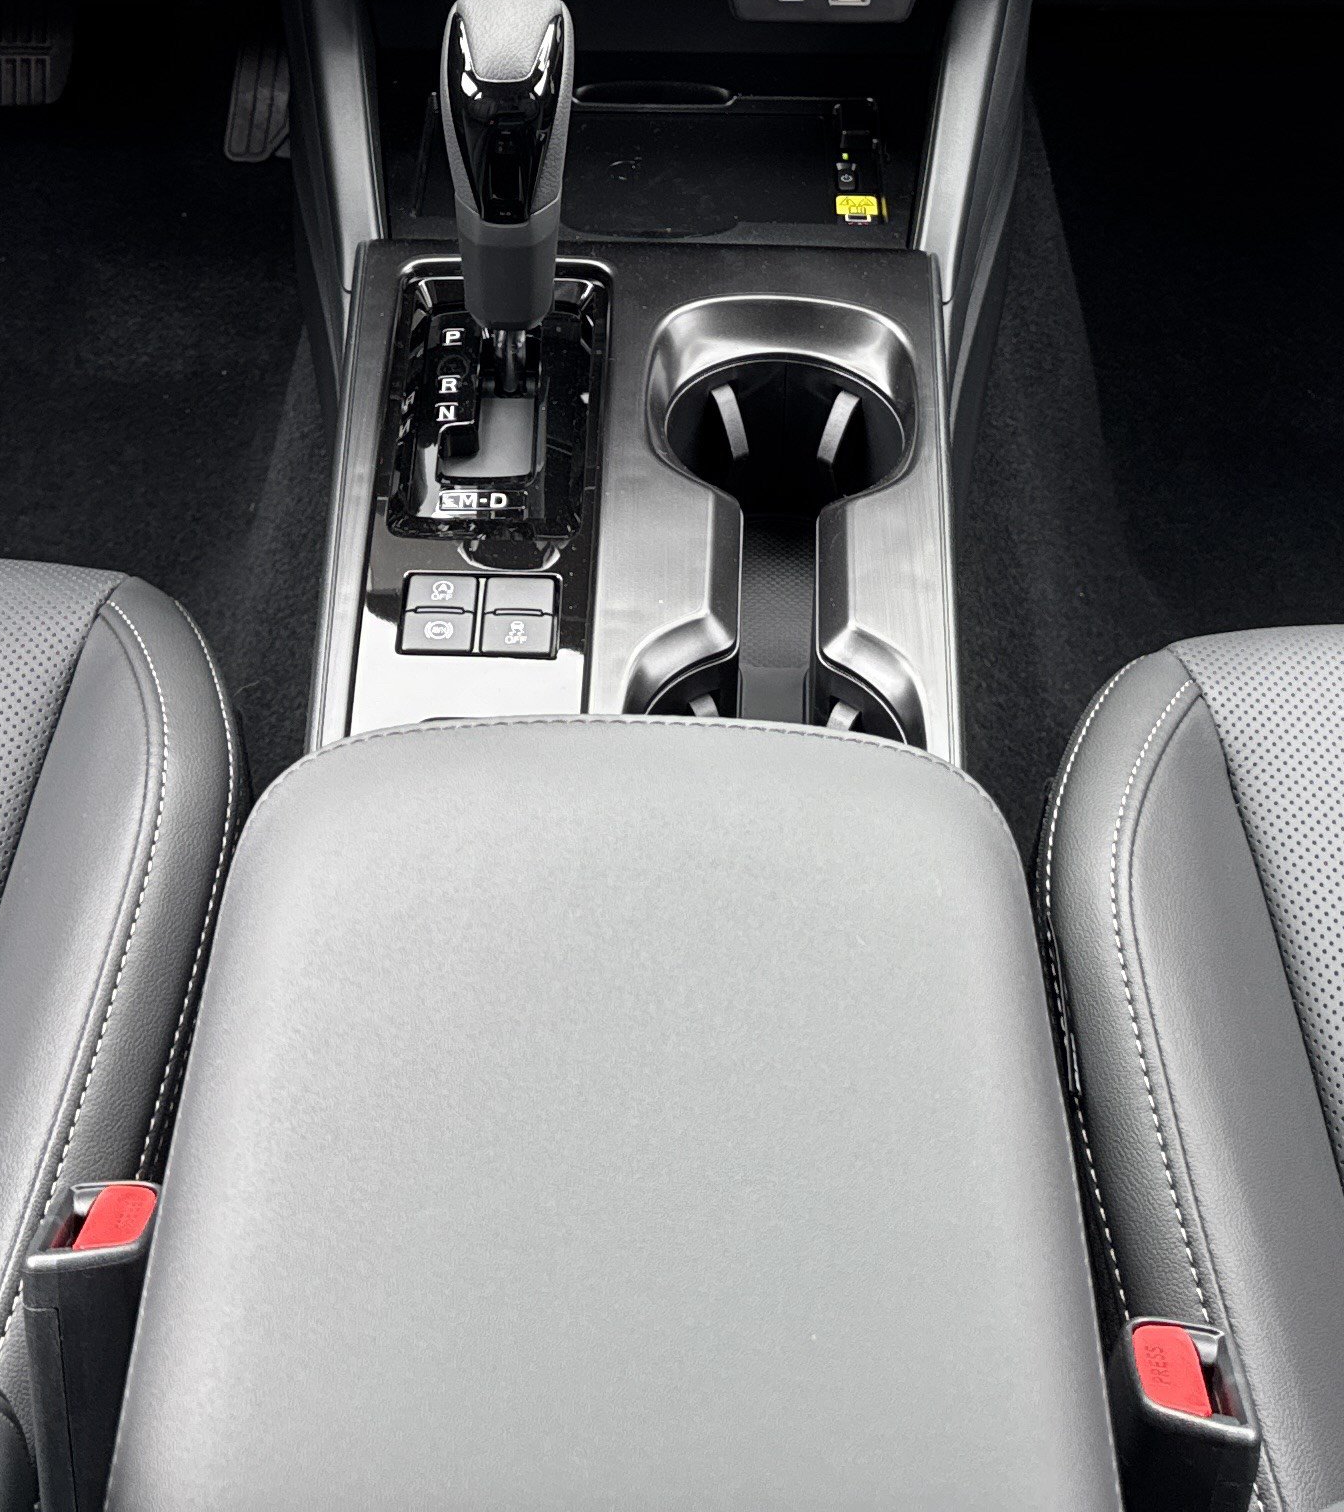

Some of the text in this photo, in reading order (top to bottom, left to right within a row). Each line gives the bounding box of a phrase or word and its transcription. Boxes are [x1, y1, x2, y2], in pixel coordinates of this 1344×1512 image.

[445, 330, 461, 345] P
[441, 377, 457, 393] R
[439, 405, 455, 420] N
[504, 636, 527, 644] OFF
